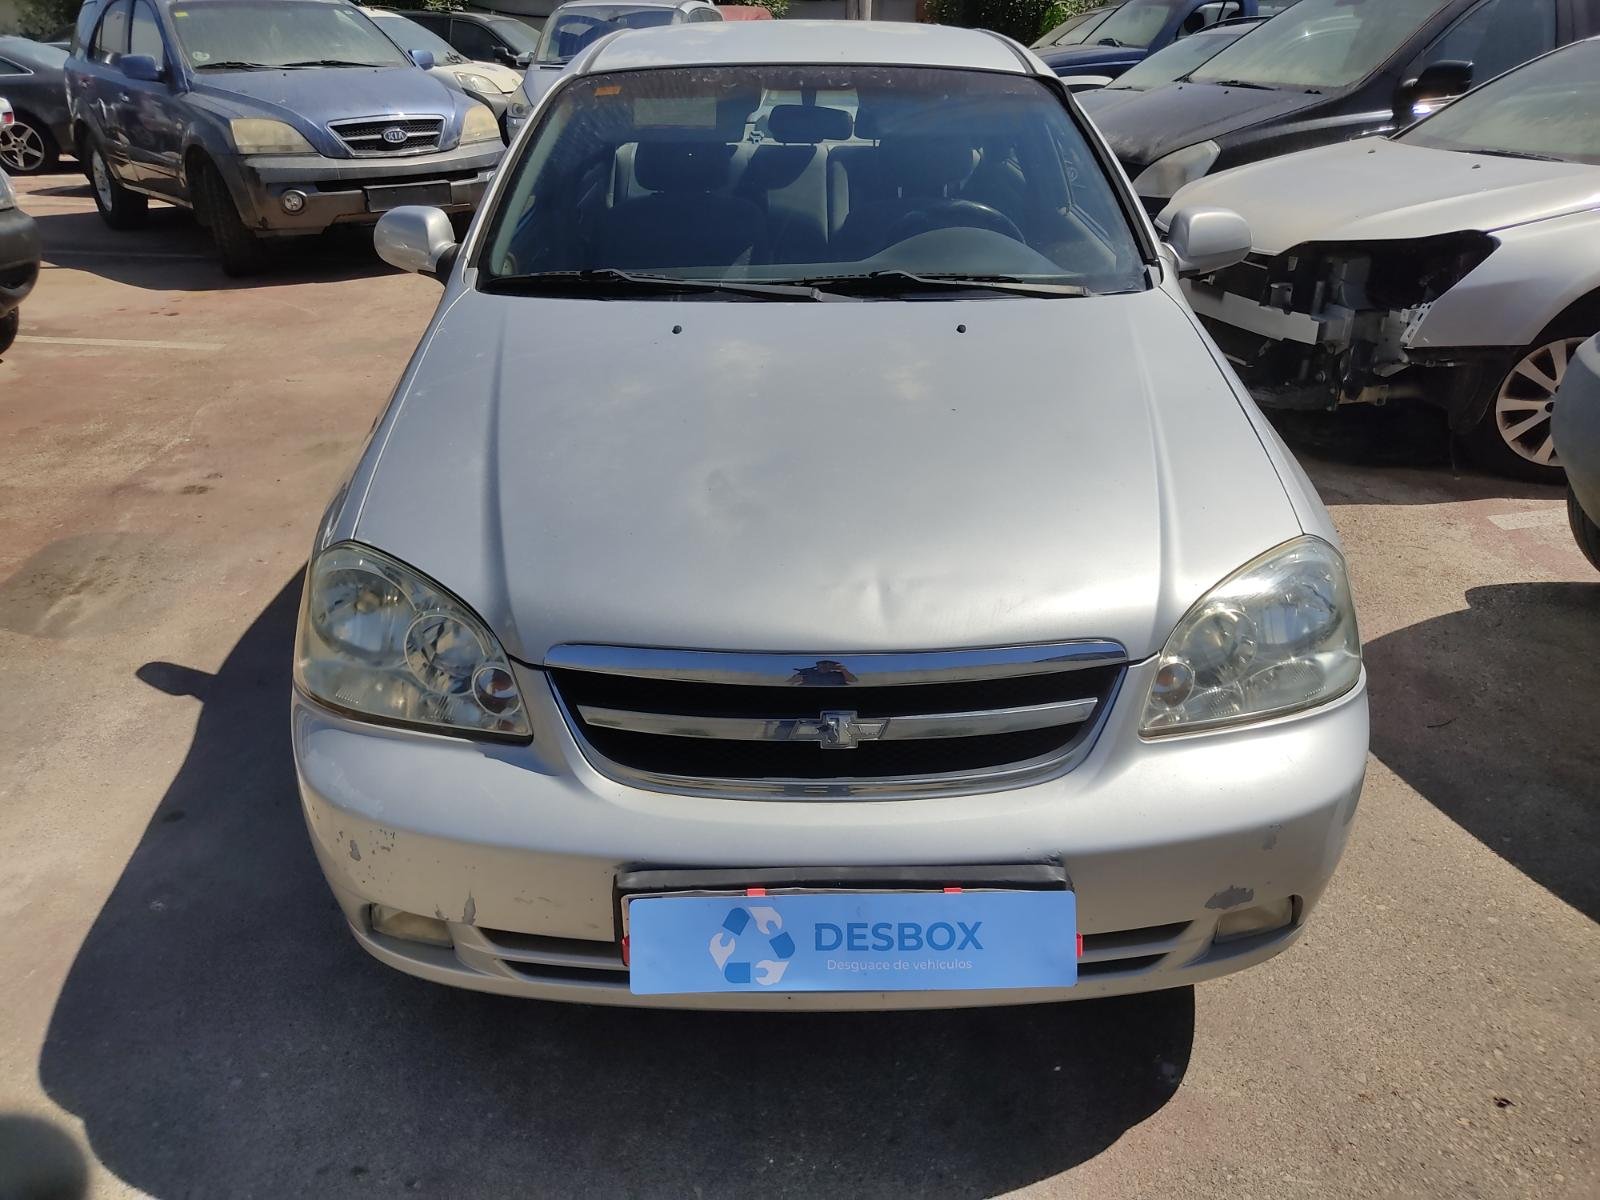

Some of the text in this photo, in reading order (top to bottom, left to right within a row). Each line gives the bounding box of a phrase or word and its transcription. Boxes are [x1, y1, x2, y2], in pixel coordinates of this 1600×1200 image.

[387, 131, 405, 140] KIA
[814, 921, 984, 951] DESBOX
[827, 959, 890, 972] Desguace
[893, 959, 910, 970] de
